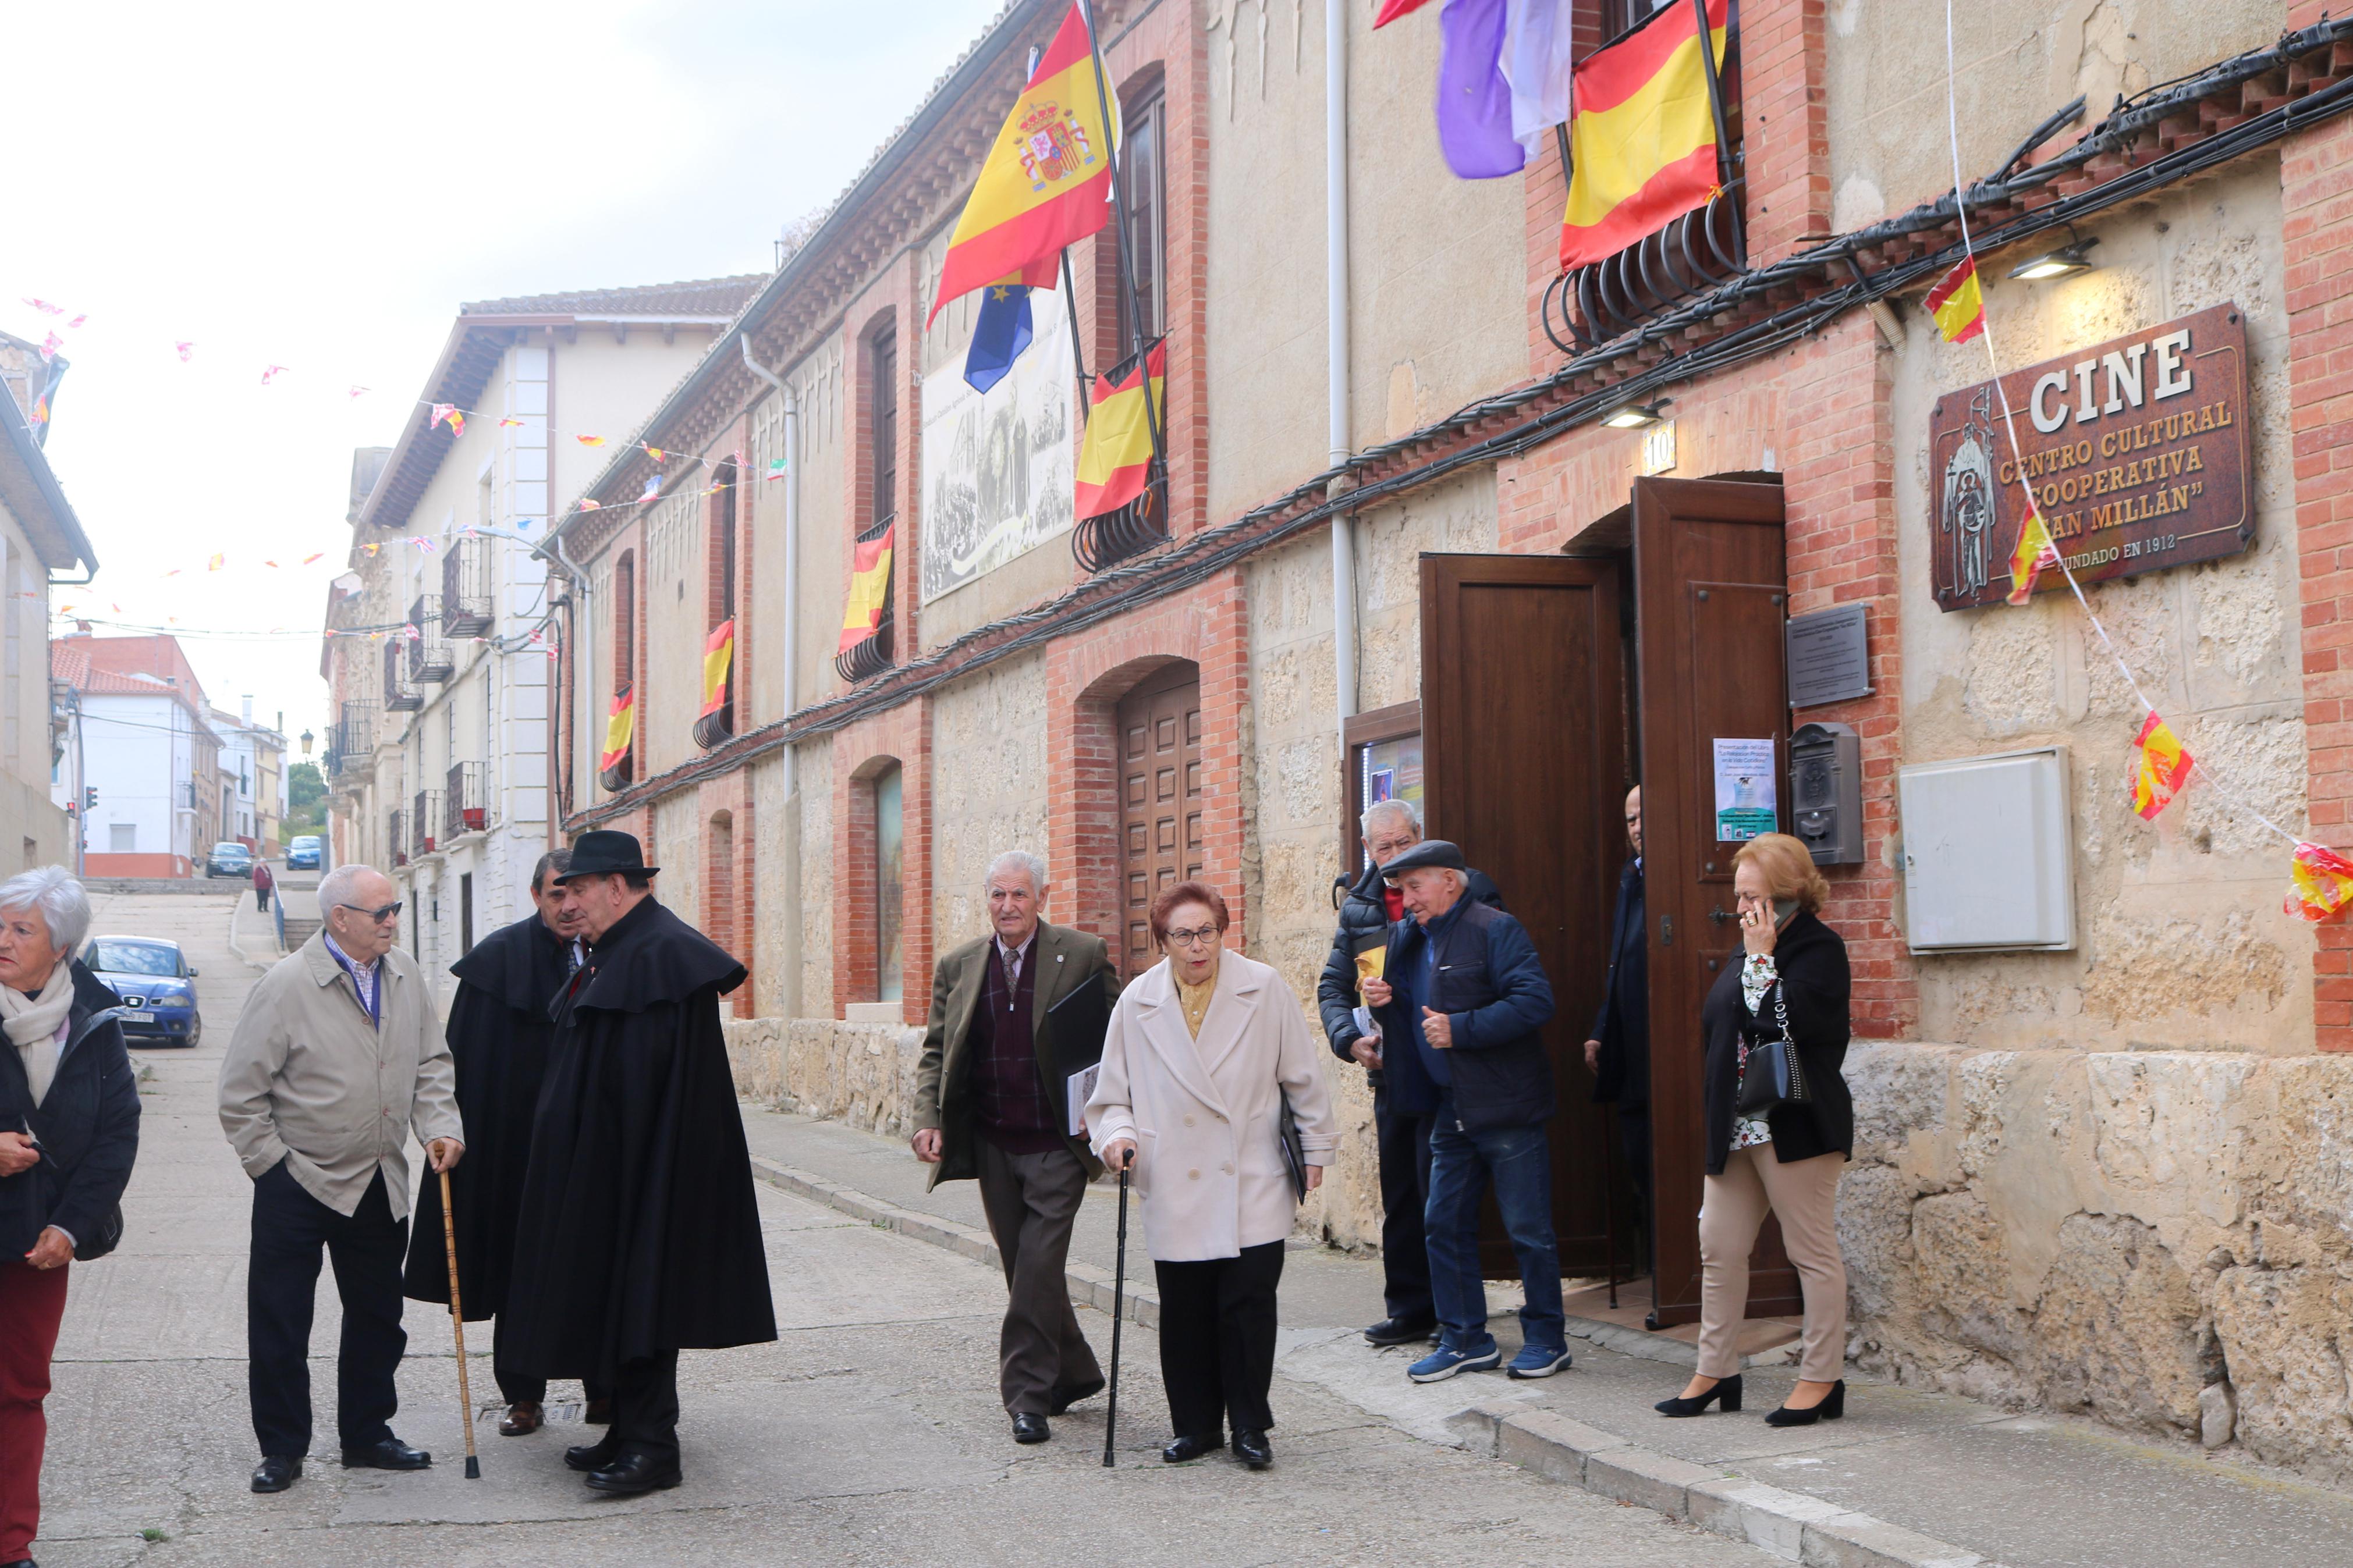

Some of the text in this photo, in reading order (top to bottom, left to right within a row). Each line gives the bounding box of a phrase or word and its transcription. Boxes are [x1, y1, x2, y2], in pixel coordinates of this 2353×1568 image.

[2030, 328, 2192, 433] CINE
[1649, 431, 1669, 466] 10
[1999, 401, 2233, 485] CENTRO CULTURAL
[2123, 541, 2141, 559] EN
[2146, 534, 2175, 554] 1912
